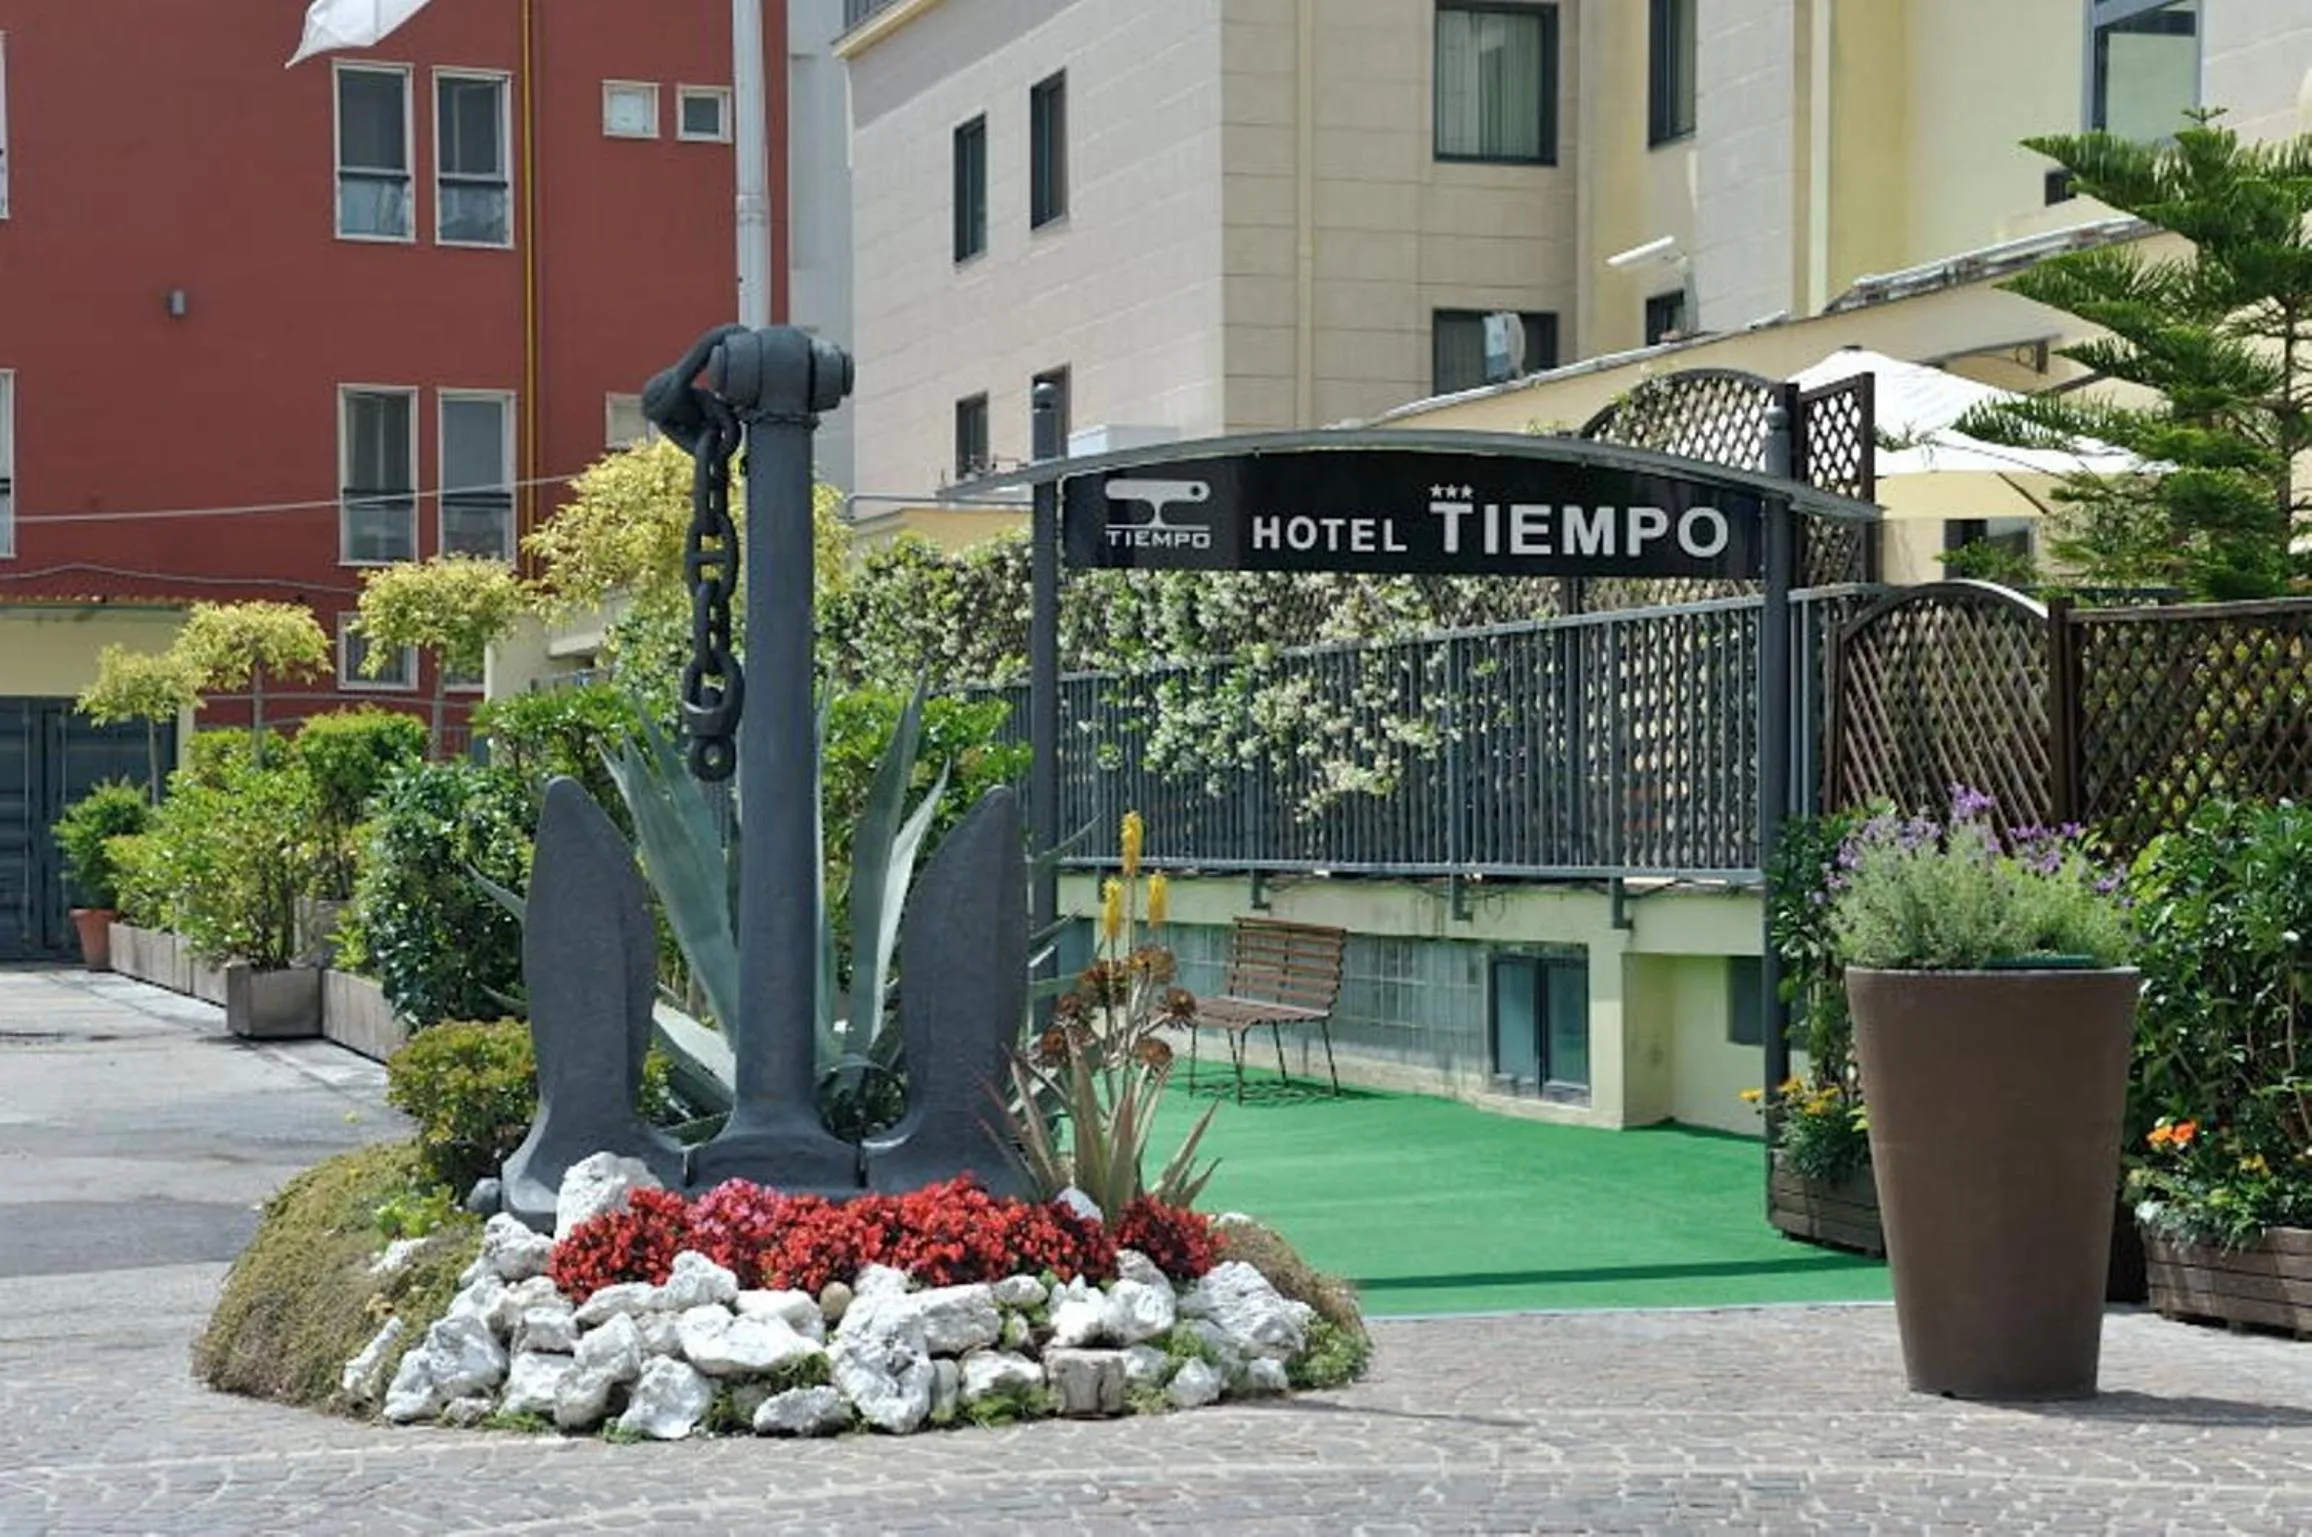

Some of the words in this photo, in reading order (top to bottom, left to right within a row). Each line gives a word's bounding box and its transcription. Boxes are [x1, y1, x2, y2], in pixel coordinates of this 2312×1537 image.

[1105, 529, 1211, 549] TIEMPO
[1253, 516, 1408, 552] HOTEL
[1429, 501, 1729, 558] TIEMPO
